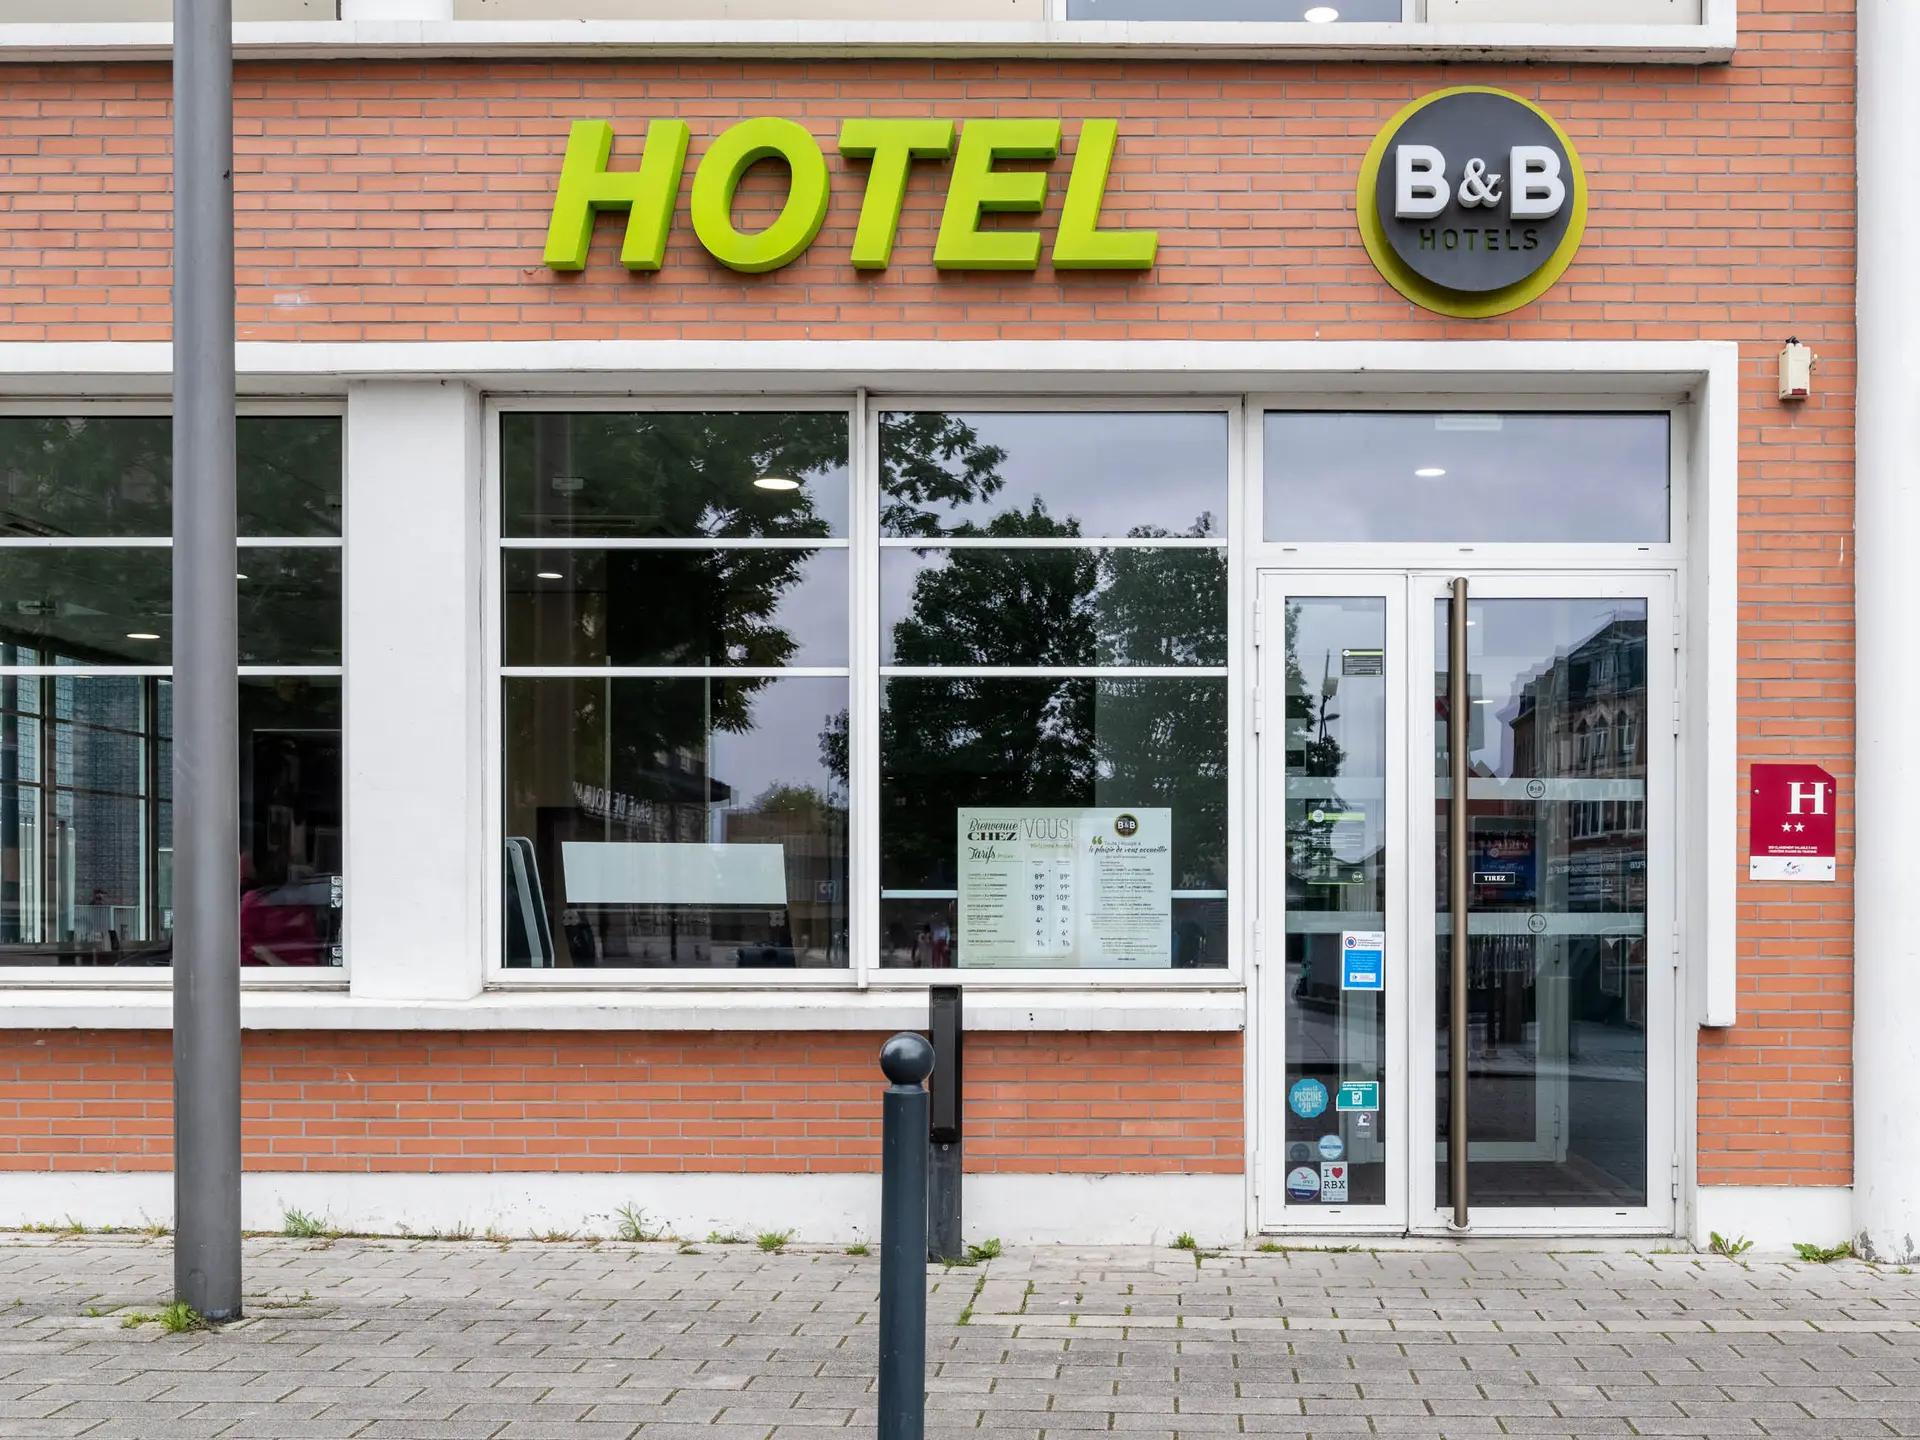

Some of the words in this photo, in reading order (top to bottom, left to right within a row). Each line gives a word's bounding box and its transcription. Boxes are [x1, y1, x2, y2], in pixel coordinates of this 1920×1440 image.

[1395, 145, 1566, 220] B&B
[543, 116, 1159, 274] HOTEL
[1419, 228, 1538, 251] HOTELS
[1786, 781, 1829, 815] H
[969, 818, 1018, 831] Bienvenue
[967, 832, 1017, 841] CHEZ
[968, 845, 996, 864] Tarifs
[1323, 1180, 1346, 1190] RBX
